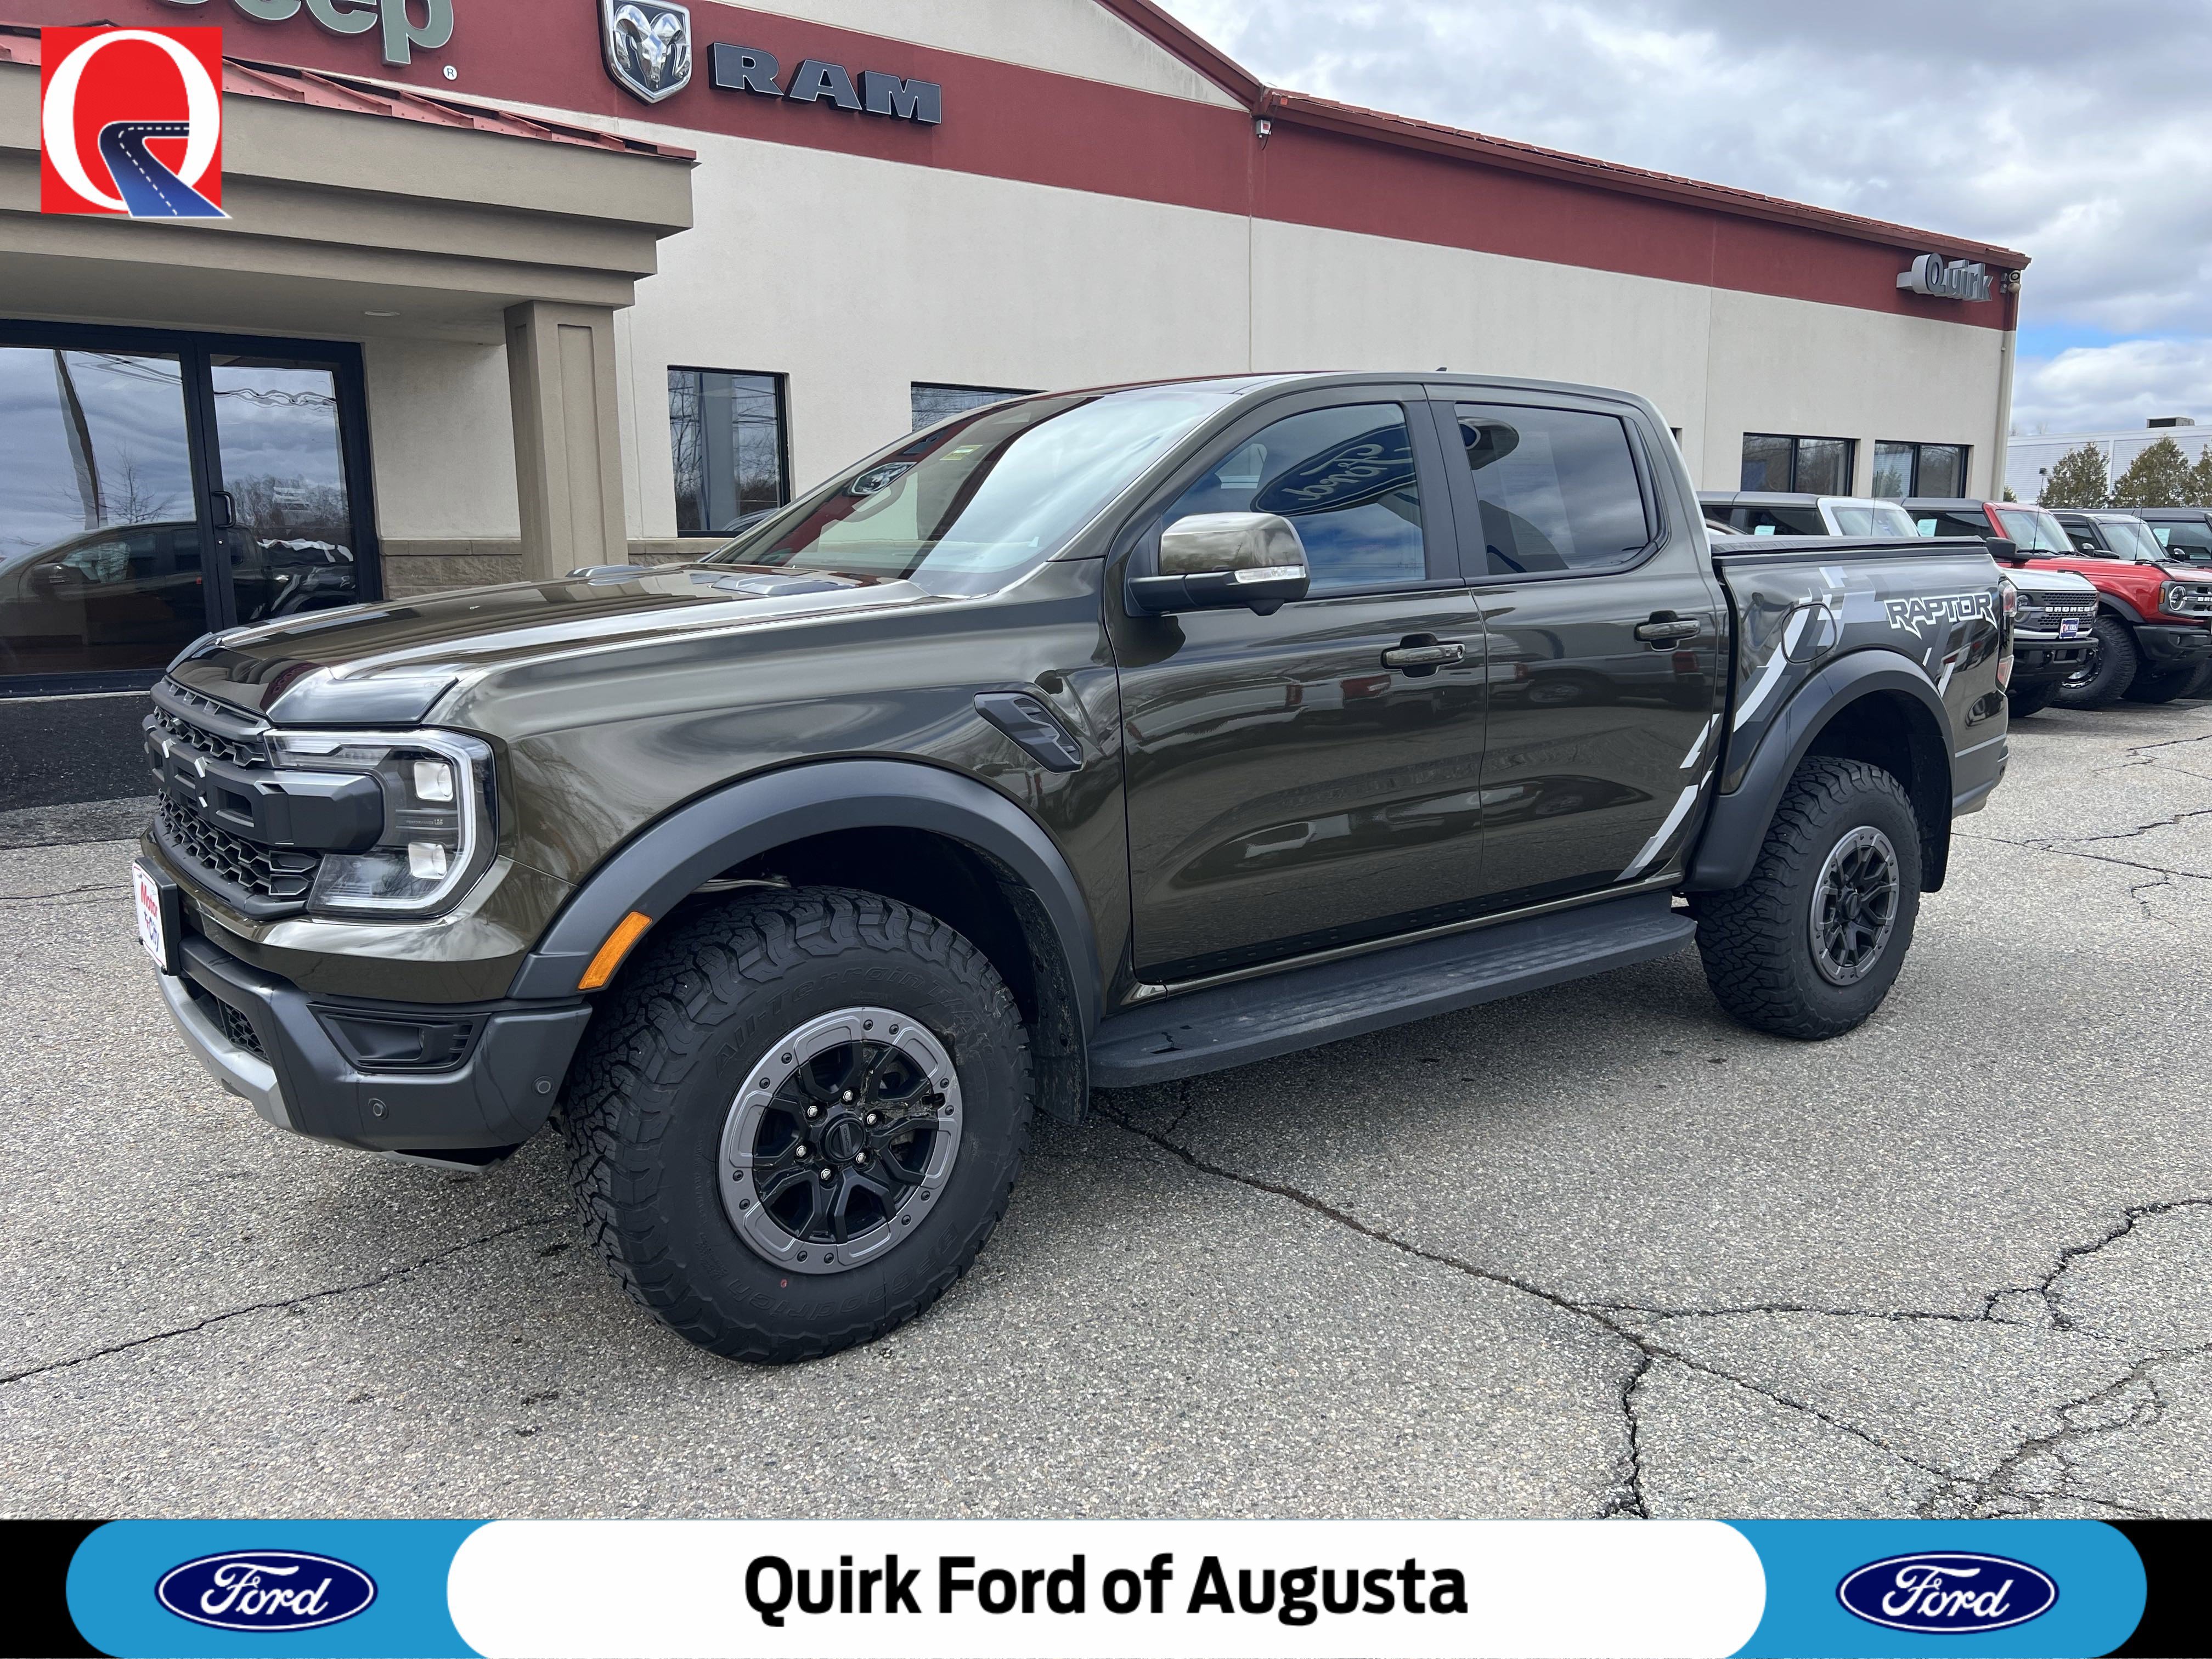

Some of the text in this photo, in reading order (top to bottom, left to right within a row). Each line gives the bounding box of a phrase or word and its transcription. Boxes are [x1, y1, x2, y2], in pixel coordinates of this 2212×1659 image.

[708, 42, 942, 126] RAM
[1919, 253, 1993, 301] Quirk
[1883, 592, 1996, 640] RAPTOR
[141, 881, 157, 918] Motor
[149, 916, 159, 952] City
[843, 1127, 851, 1153] FORD
[725, 1221, 959, 1321] BFGoodrich
